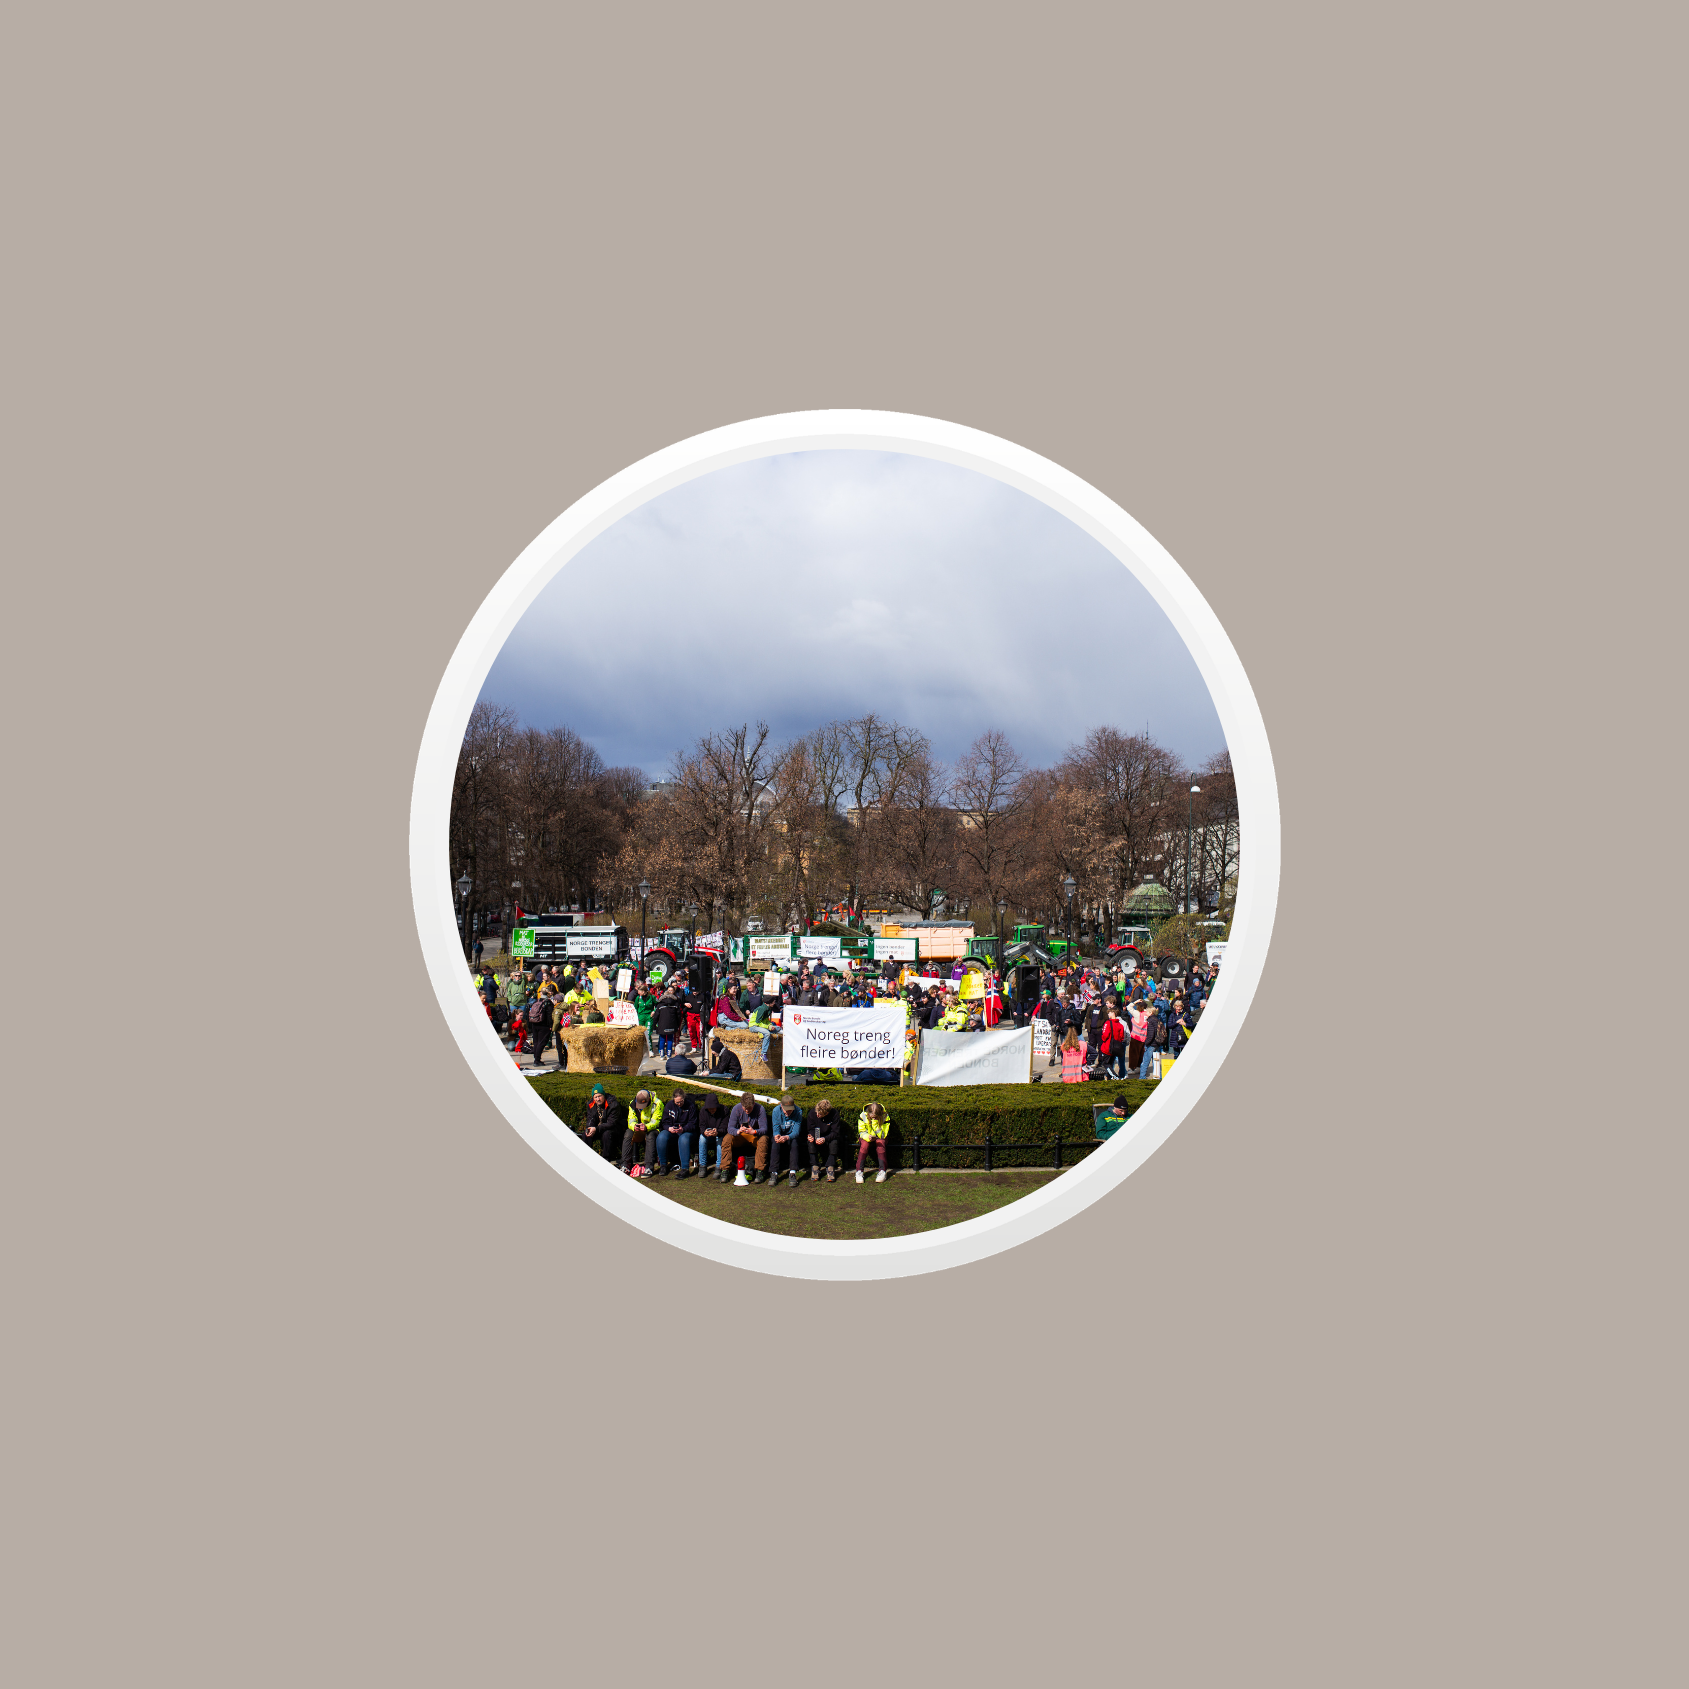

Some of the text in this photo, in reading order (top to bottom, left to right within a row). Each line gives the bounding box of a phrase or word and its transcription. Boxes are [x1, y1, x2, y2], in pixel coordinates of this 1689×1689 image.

[806, 1028, 891, 1045] Noreg treng
[800, 1045, 895, 1060] fleire bønder!
